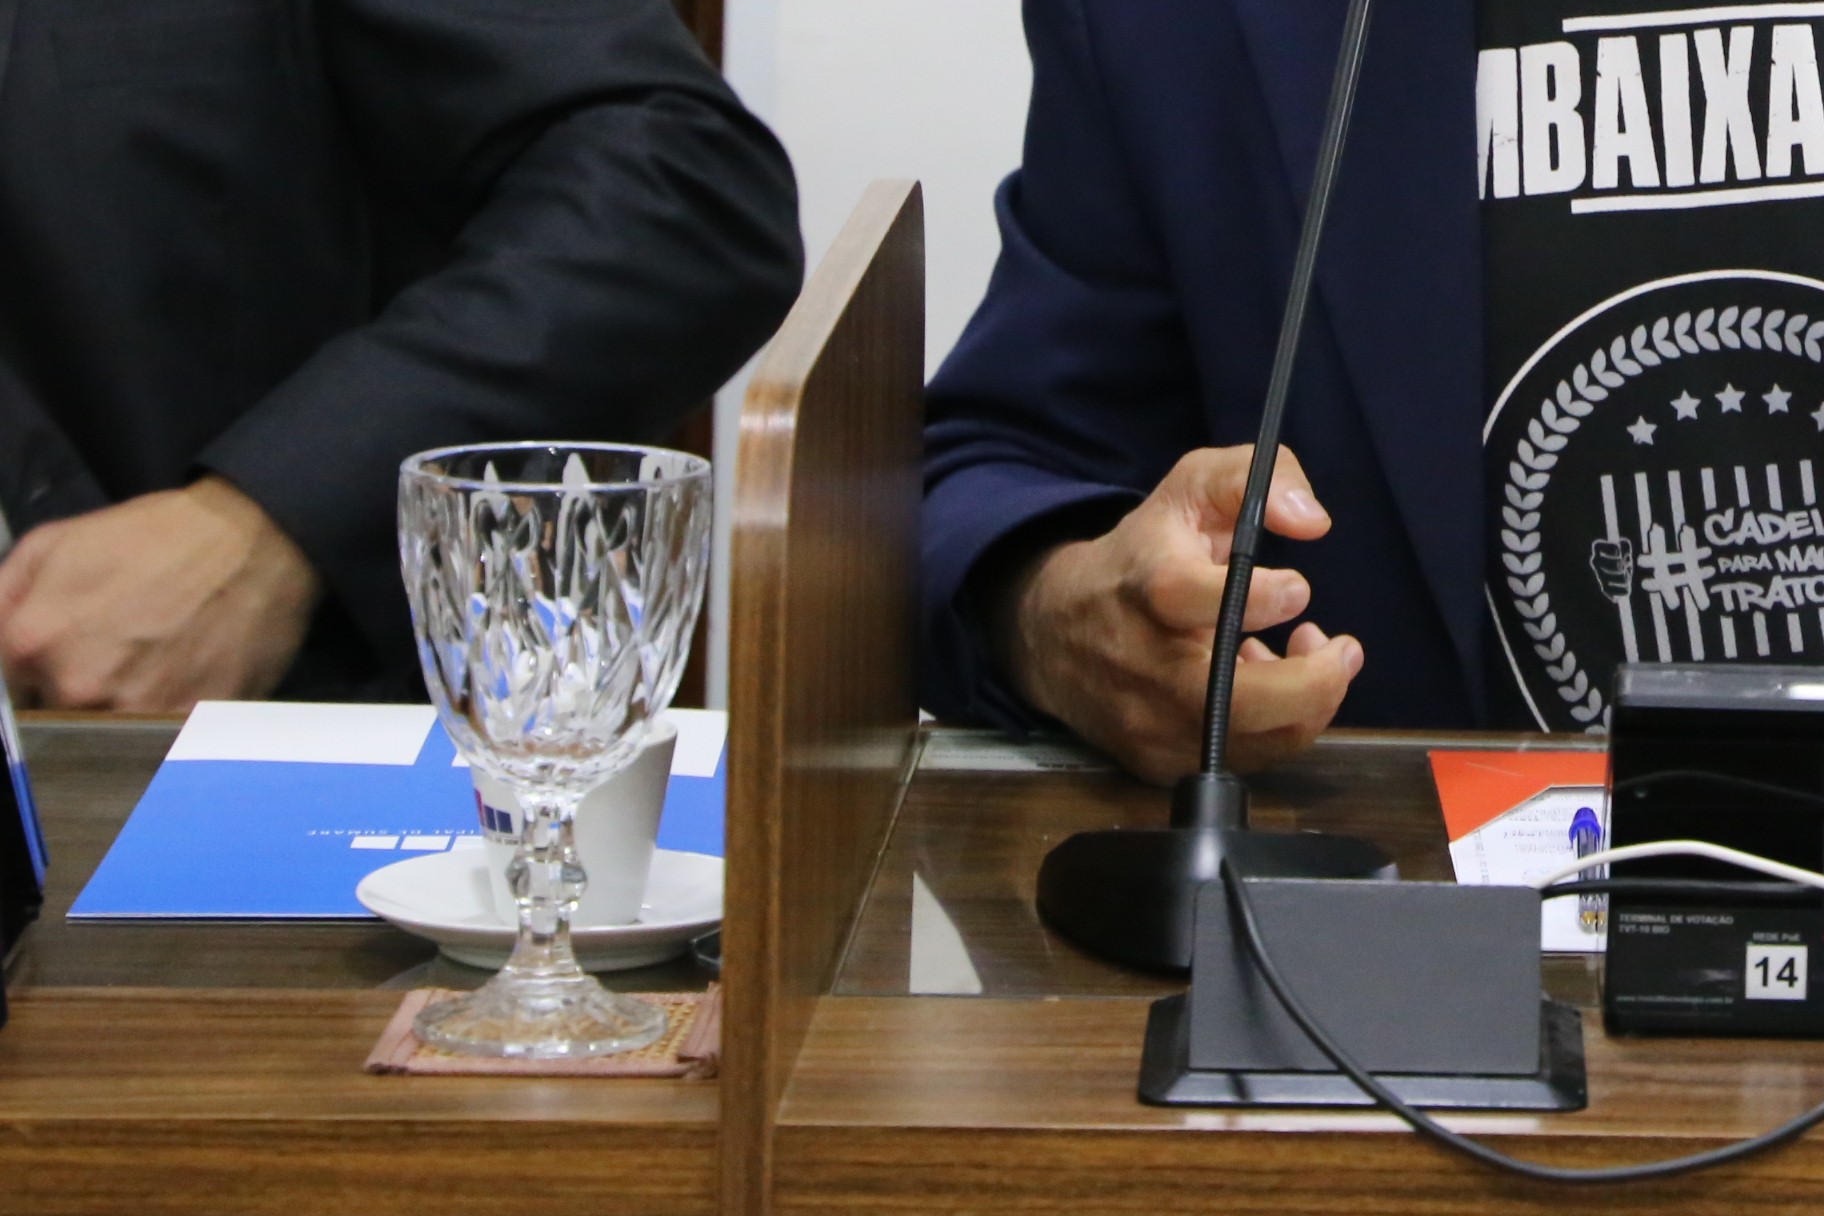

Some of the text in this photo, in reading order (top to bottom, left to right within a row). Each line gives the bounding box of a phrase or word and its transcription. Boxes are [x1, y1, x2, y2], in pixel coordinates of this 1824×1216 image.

[1718, 552, 1772, 573] PARA
[1670, 915, 1683, 924] DE
[1754, 956, 1798, 988] 14
